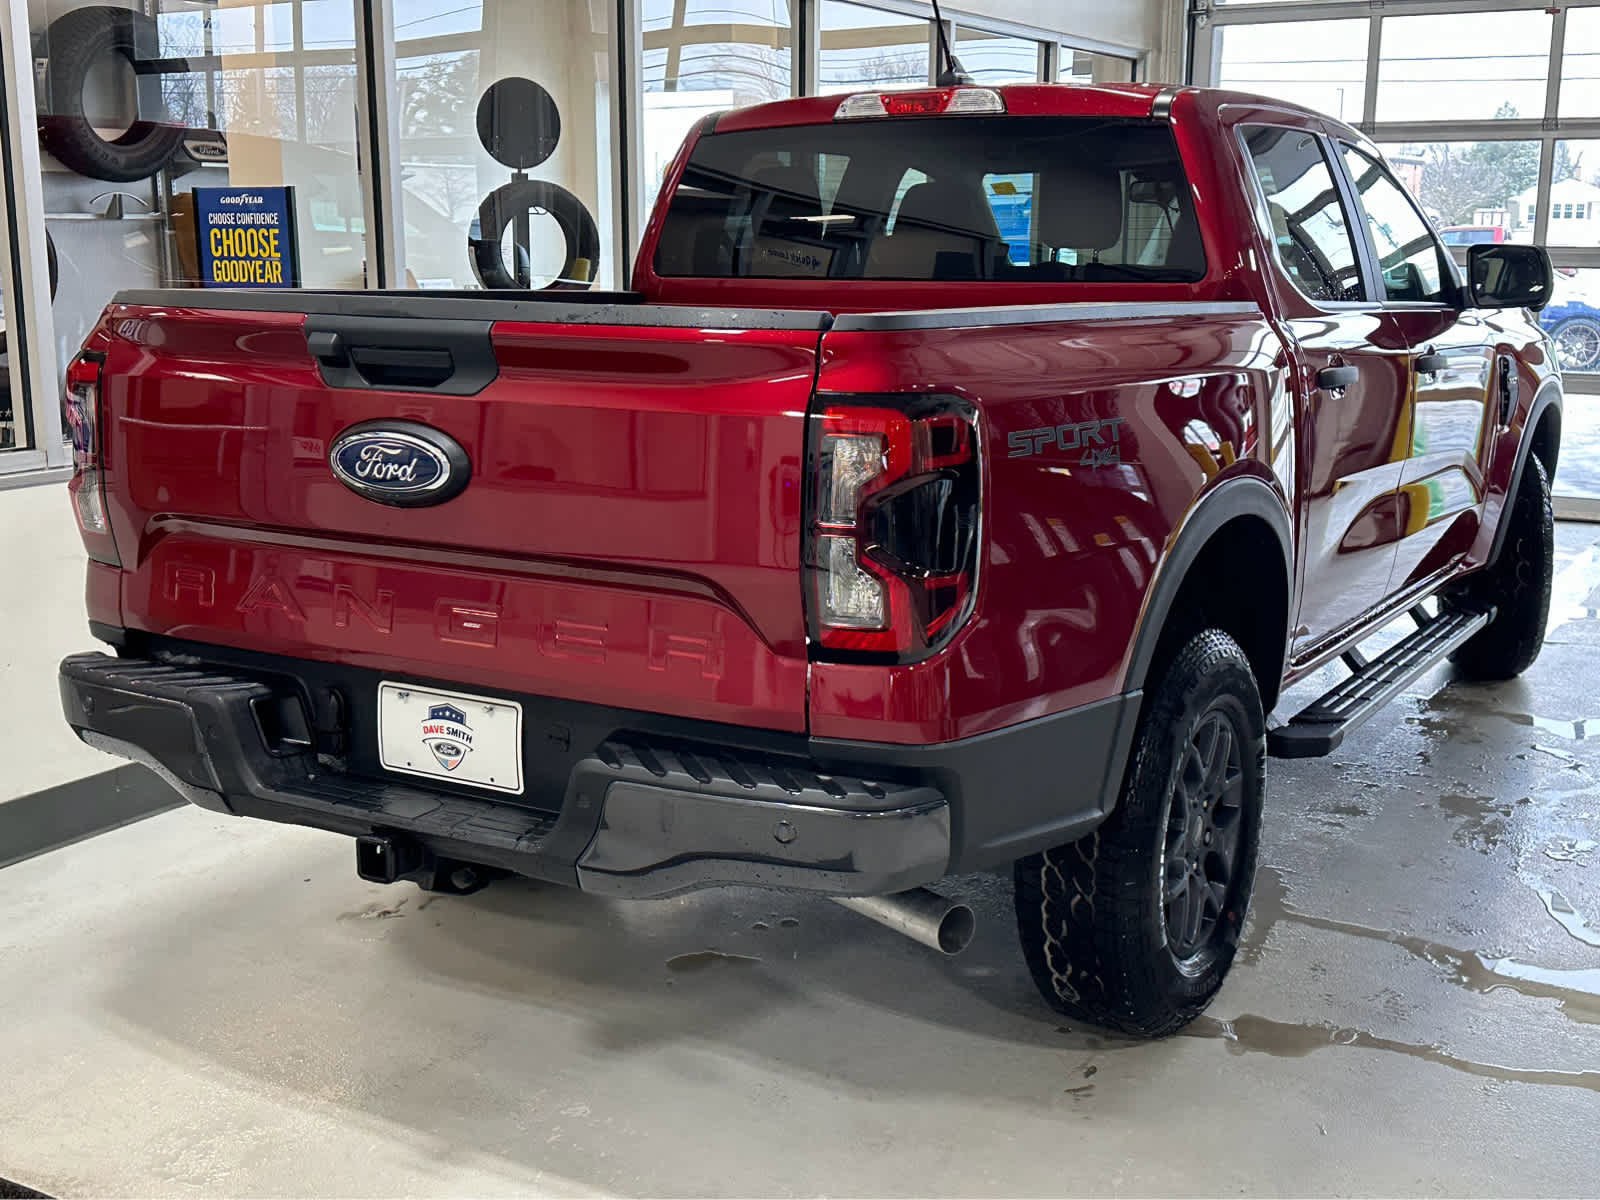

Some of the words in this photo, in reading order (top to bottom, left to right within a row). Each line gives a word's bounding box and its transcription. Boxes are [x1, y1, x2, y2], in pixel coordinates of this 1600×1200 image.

[220, 193, 264, 206] GOODYEAR
[208, 212, 235, 225] CHOOSE
[236, 212, 279, 225] CONFIDENCE
[210, 227, 281, 258] CHOOSE
[212, 259, 283, 284] GOODYEAR
[1007, 416, 1126, 459] SPORT
[354, 444, 418, 482] Ford
[169, 566, 722, 680] RANGER
[423, 725, 445, 735] DAVE
[446, 726, 473, 744] SMITH
